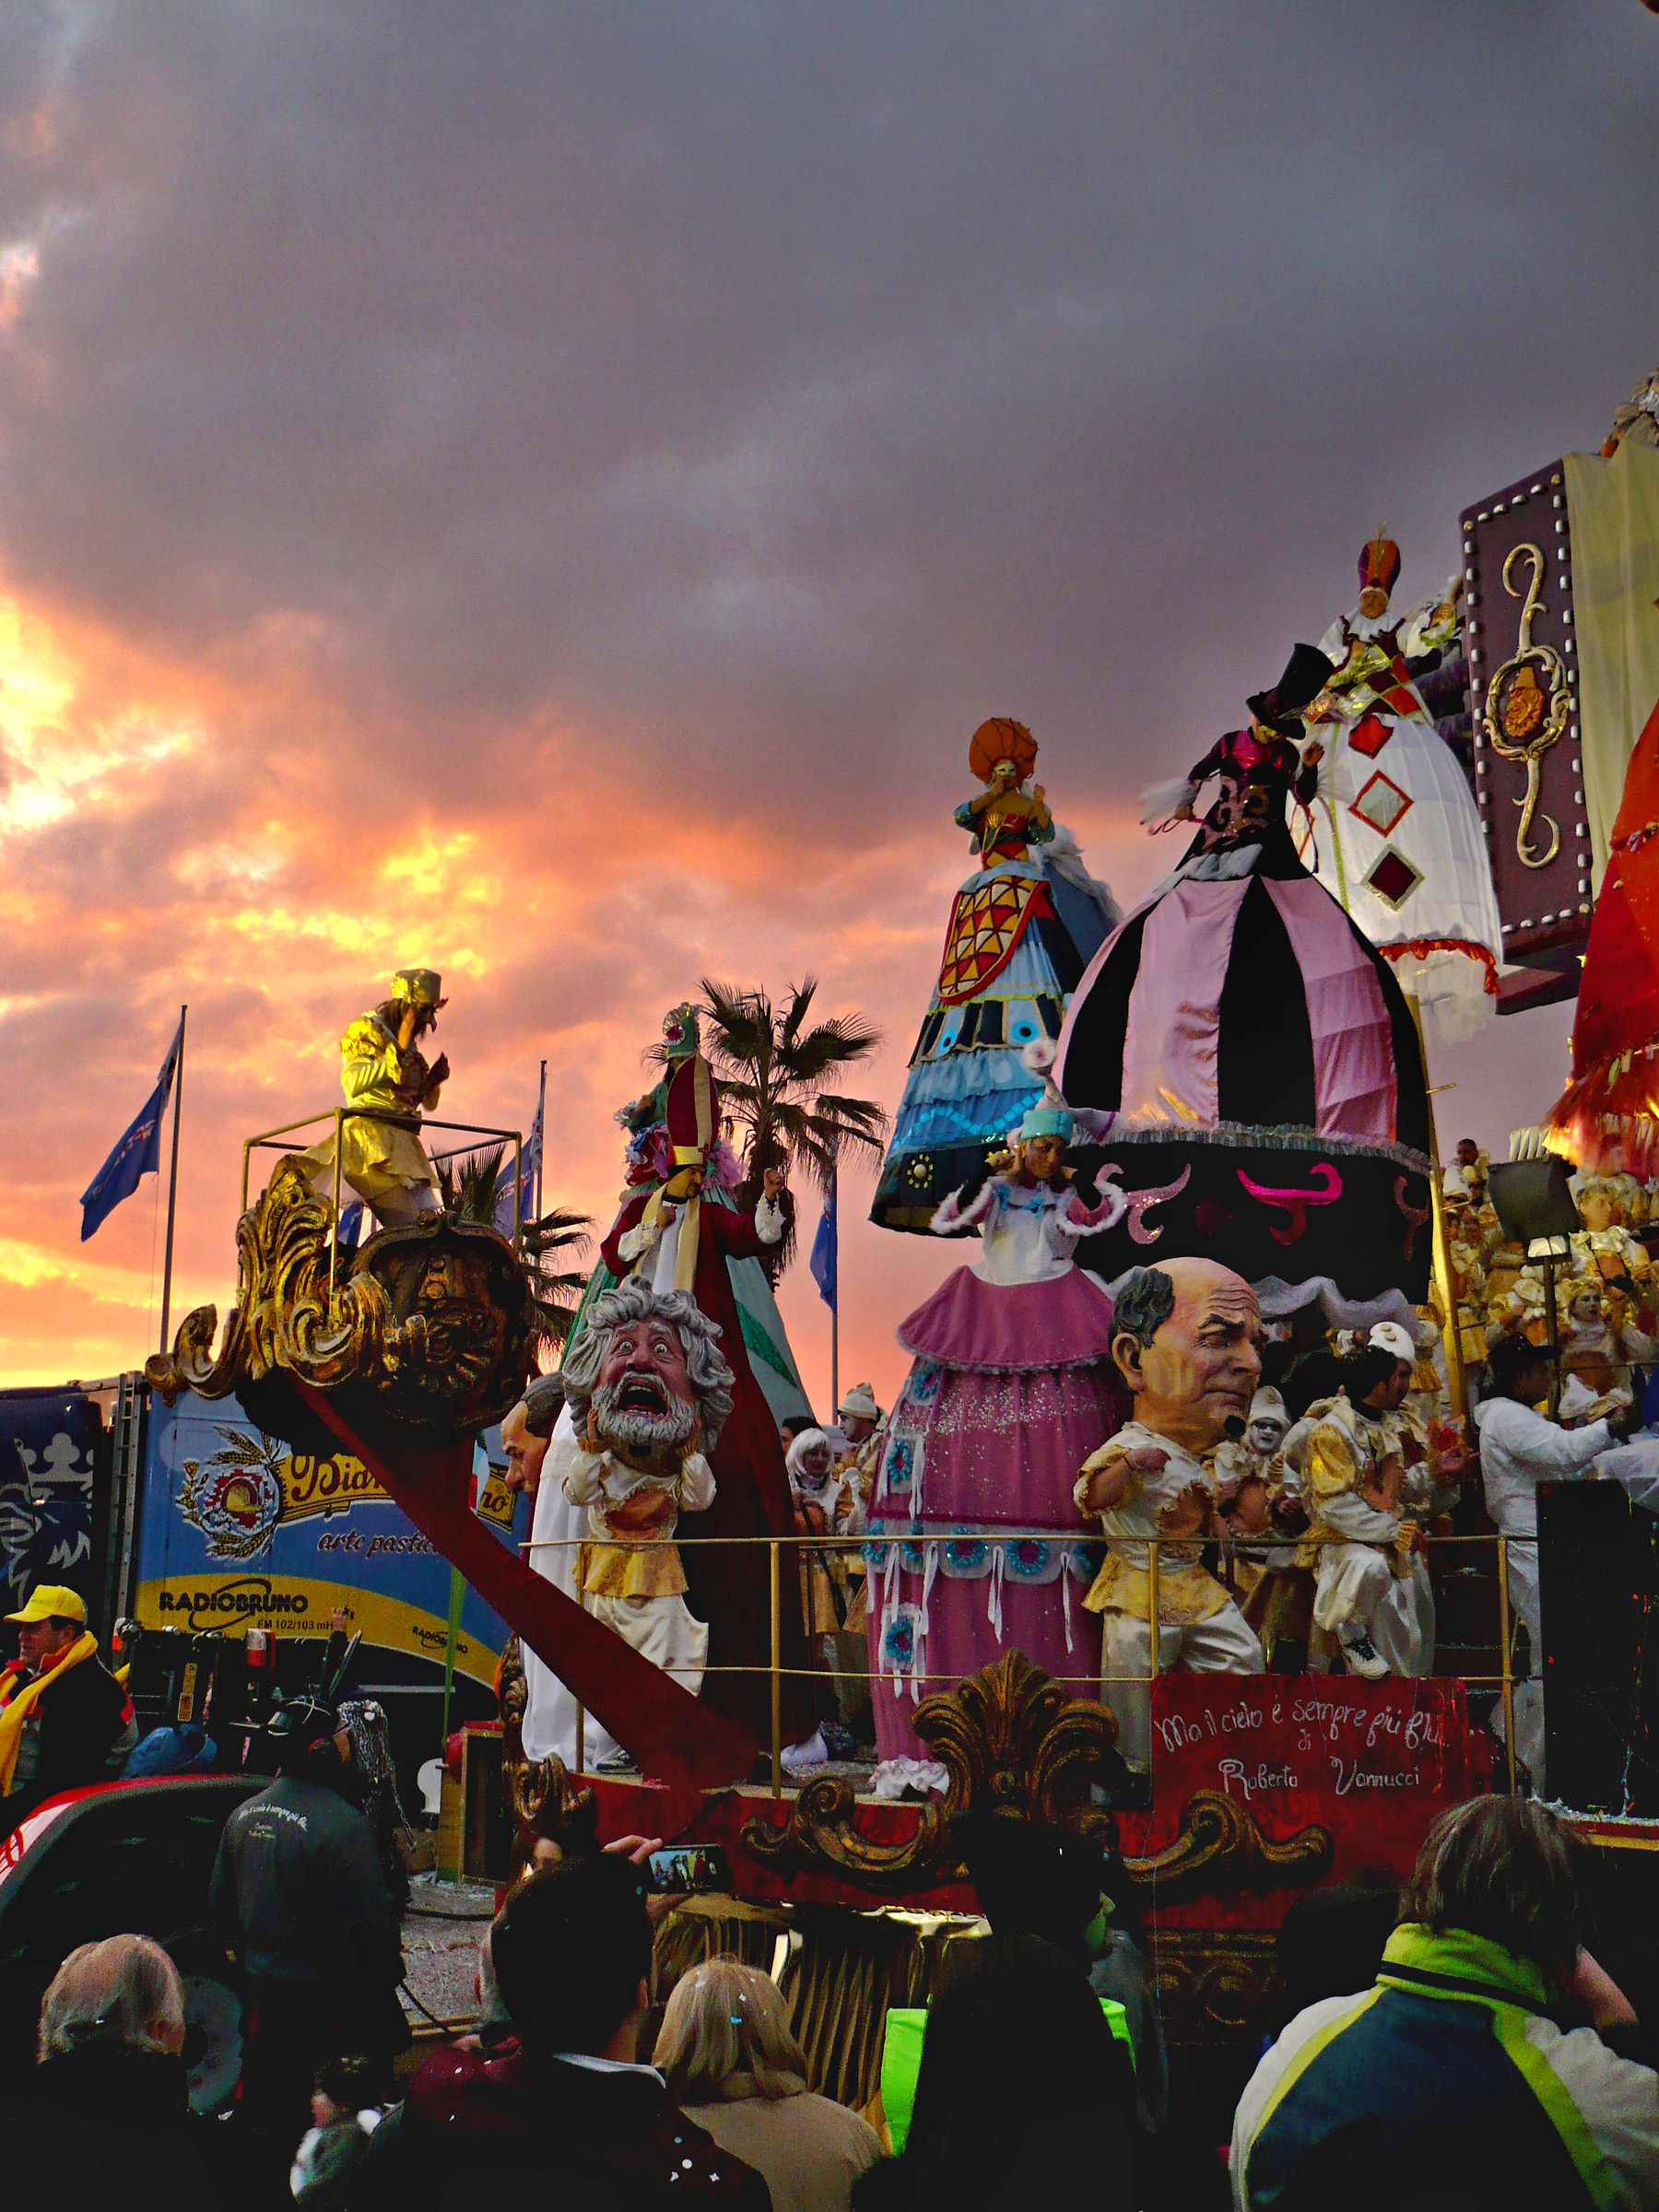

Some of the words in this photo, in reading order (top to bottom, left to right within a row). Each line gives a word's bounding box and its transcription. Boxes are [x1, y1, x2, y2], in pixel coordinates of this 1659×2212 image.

[317, 1528, 365, 1553] arte
[159, 1591, 309, 1614] RADIOBRUNO
[258, 1619, 273, 1630] FM
[276, 1619, 314, 1630] 102/103
[317, 1619, 334, 1630] mH
[1204, 1709, 1218, 1736] il
[1221, 1700, 1264, 1733] cielo
[1292, 1699, 1368, 1740] sempre
[1298, 1727, 1312, 1750] di
[1218, 1758, 1299, 1800] Roberto
[1329, 1756, 1420, 1795] Vannucci
